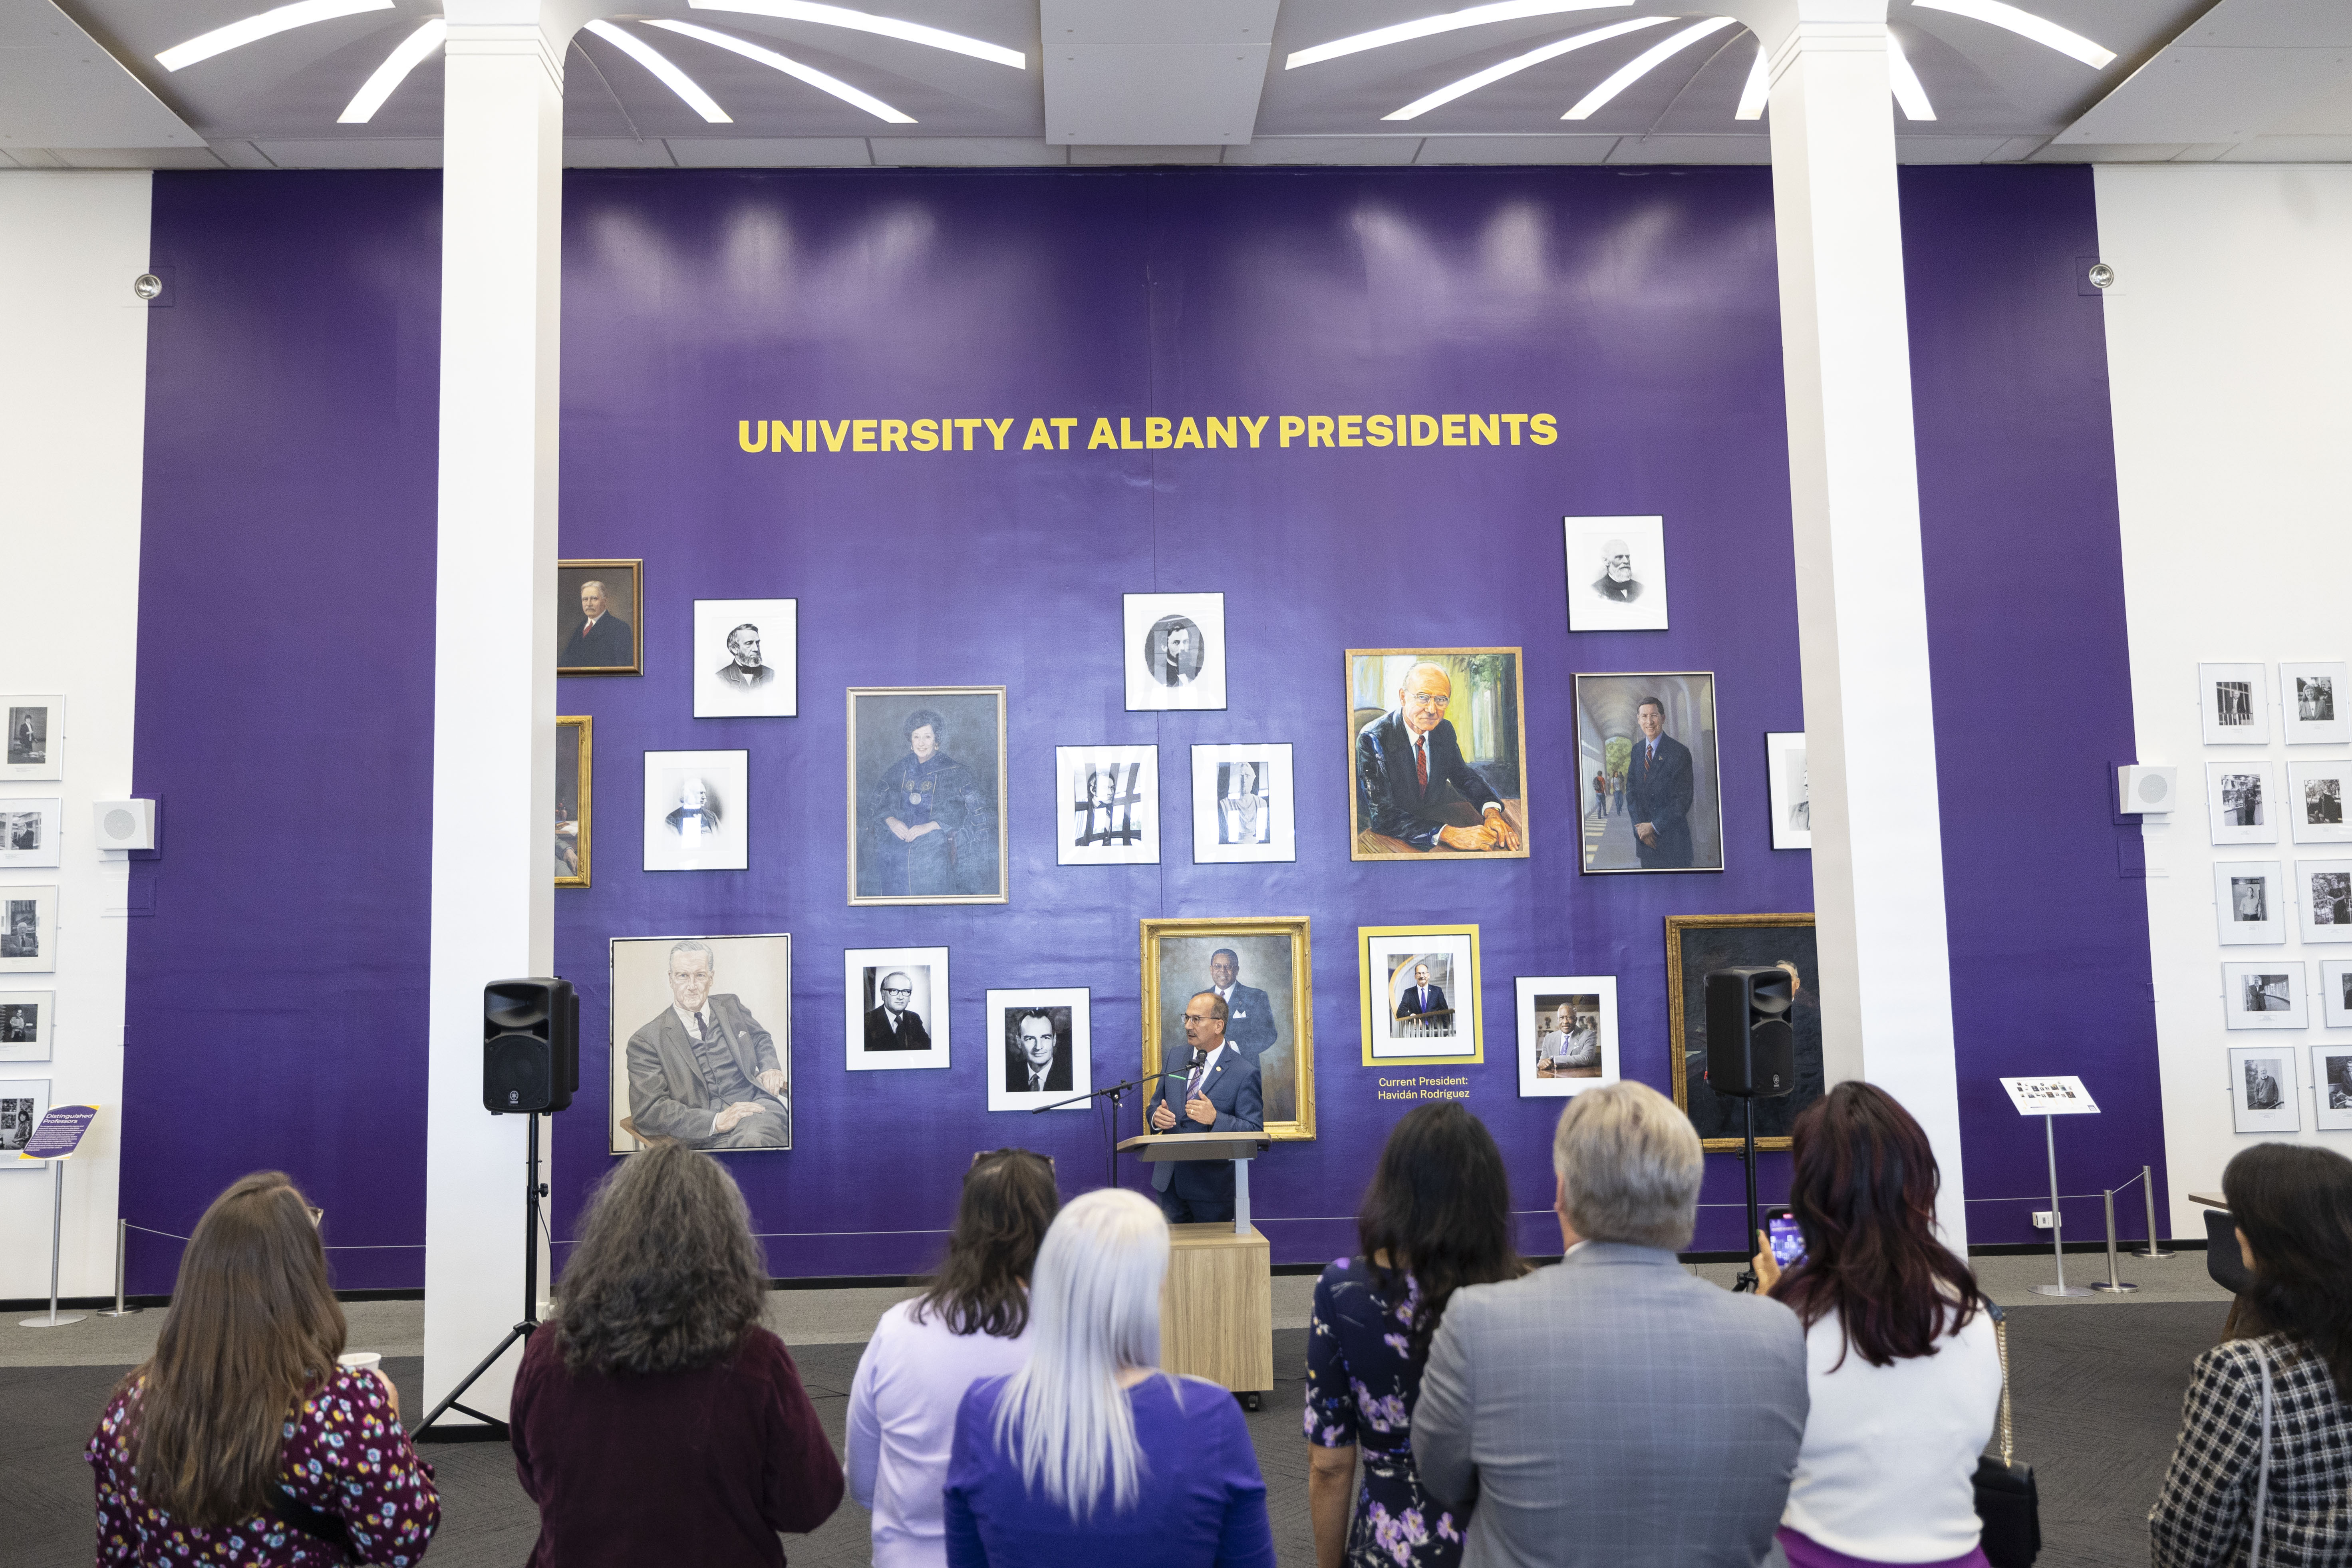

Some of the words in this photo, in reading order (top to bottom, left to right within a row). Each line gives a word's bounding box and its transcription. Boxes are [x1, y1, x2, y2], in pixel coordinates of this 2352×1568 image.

[739, 418, 1013, 453] UNIVERSITY
[1023, 418, 1077, 449] AT
[1088, 416, 1269, 449] ALBANY
[1280, 413, 1557, 447] PRESIDENTS
[1379, 1078, 1416, 1087] Current
[1419, 1076, 1468, 1086] President:
[1378, 1090, 1418, 1100] Havidán
[1420, 1089, 1470, 1100] Rodríguez
